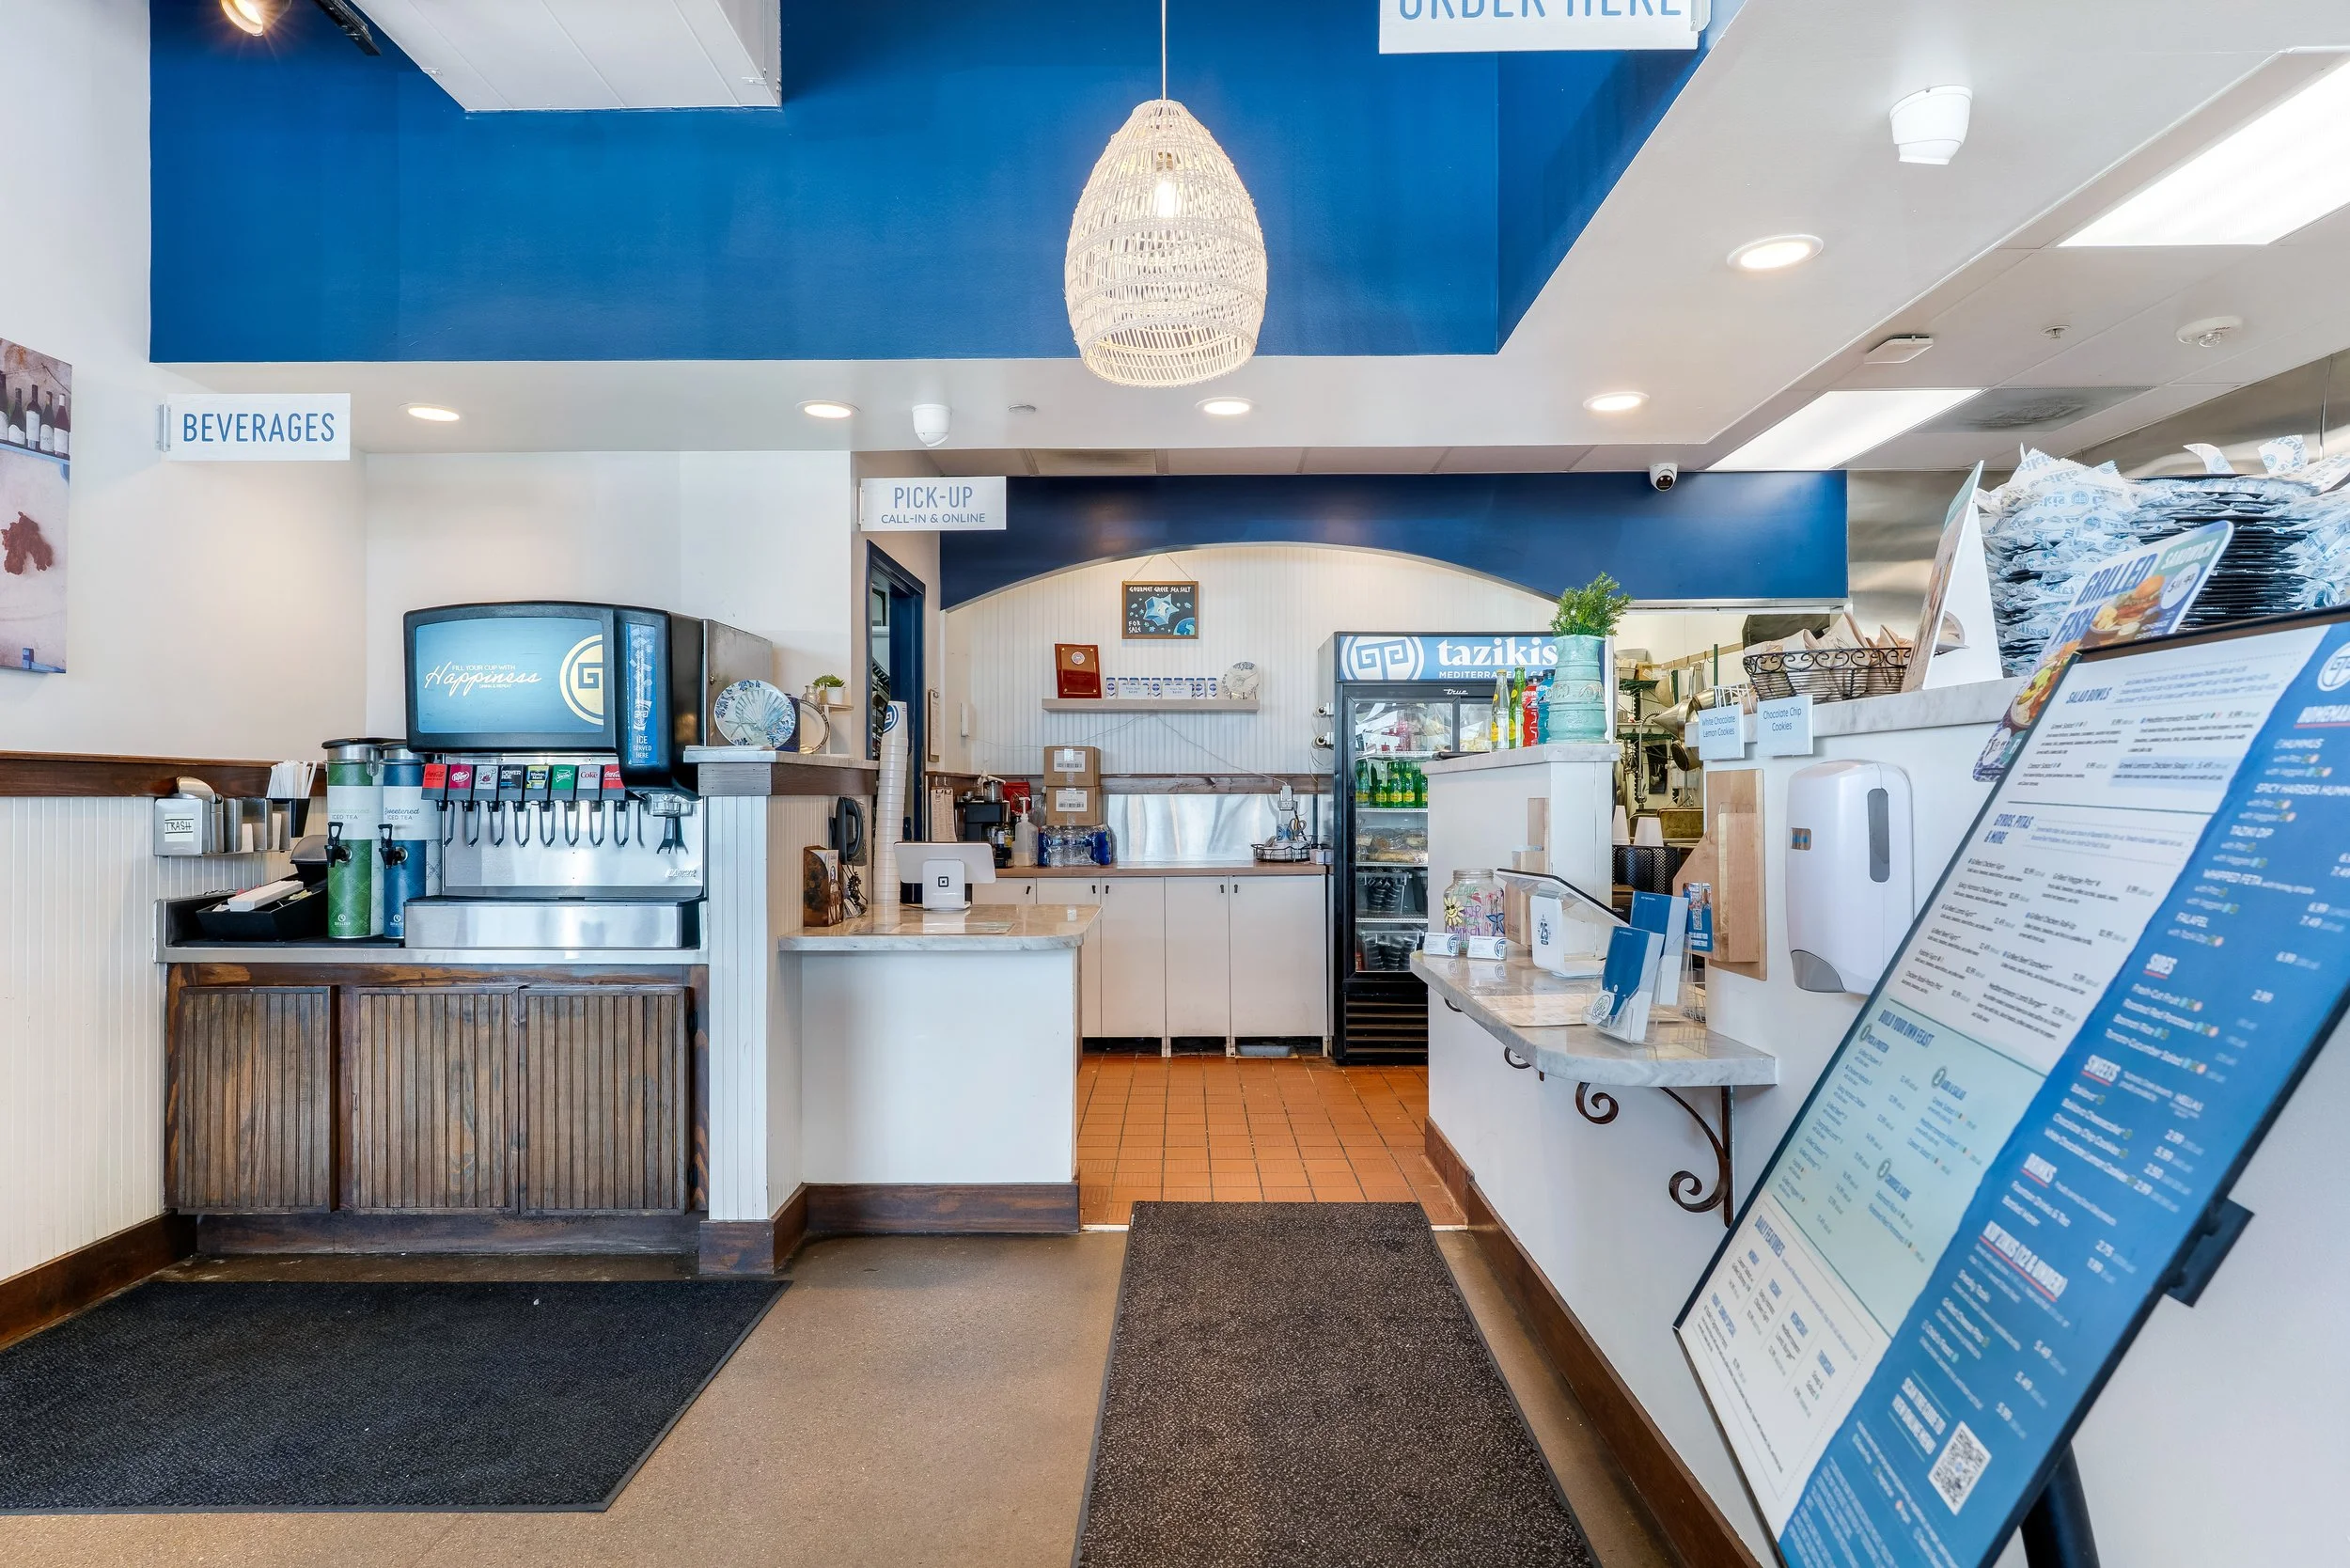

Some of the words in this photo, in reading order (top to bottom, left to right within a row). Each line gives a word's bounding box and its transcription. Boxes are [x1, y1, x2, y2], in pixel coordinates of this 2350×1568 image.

[182, 413, 335, 443] BEVERAGES
[894, 486, 973, 509] PICK-UP
[881, 514, 927, 524] CALL-IN
[930, 513, 939, 524] &
[942, 513, 986, 523] ONLINE
[2076, 552, 2159, 606] GRILLED
[2050, 604, 2103, 649] FISH
[424, 661, 542, 697] Happiness
[2064, 689, 2091, 704] SALAD
[2084, 686, 2114, 701] BOWLS
[1701, 717, 1714, 727] White
[1714, 715, 1736, 725] Chocolate
[1762, 709, 1789, 720] Chocolate
[1789, 706, 1802, 719] Chip
[1702, 729, 1716, 738] Lemon
[1717, 727, 1735, 736] Cookies
[1771, 721, 1793, 732] Cookies
[636, 736, 648, 745] ICE
[580, 771, 598, 779] Coke
[384, 808, 420, 816] Sweetened
[164, 821, 192, 831] TRASH
[1982, 829, 1994, 842] &
[1987, 830, 2009, 844] MORE
[1540, 922, 1549, 941] 25
[2144, 952, 2179, 976] SIDES
[1877, 1009, 1896, 1027] BUILD
[1890, 1015, 1908, 1034] YOUR
[1903, 1022, 1919, 1040] OWN
[1913, 1027, 1935, 1048] FEAST
[2082, 1054, 2123, 1083] SWEETS
[2022, 1151, 2059, 1185] DRINKS
[1753, 1214, 1769, 1236] DAILY
[1762, 1226, 1785, 1259] FEATURES
[2012, 1243, 2033, 1270] (12
[2023, 1252, 2039, 1275] &
[2029, 1257, 2070, 1300] UNDER)
[1901, 1375, 1919, 1402] SCAN
[1912, 1390, 1927, 1412] THE
[1920, 1401, 1940, 1429] CODE
[1934, 1417, 1947, 1437] TO
[1890, 1392, 1908, 1419] VIEW
[1901, 1407, 1922, 1438] ONLINE
[1916, 1426, 1936, 1457] MENU
